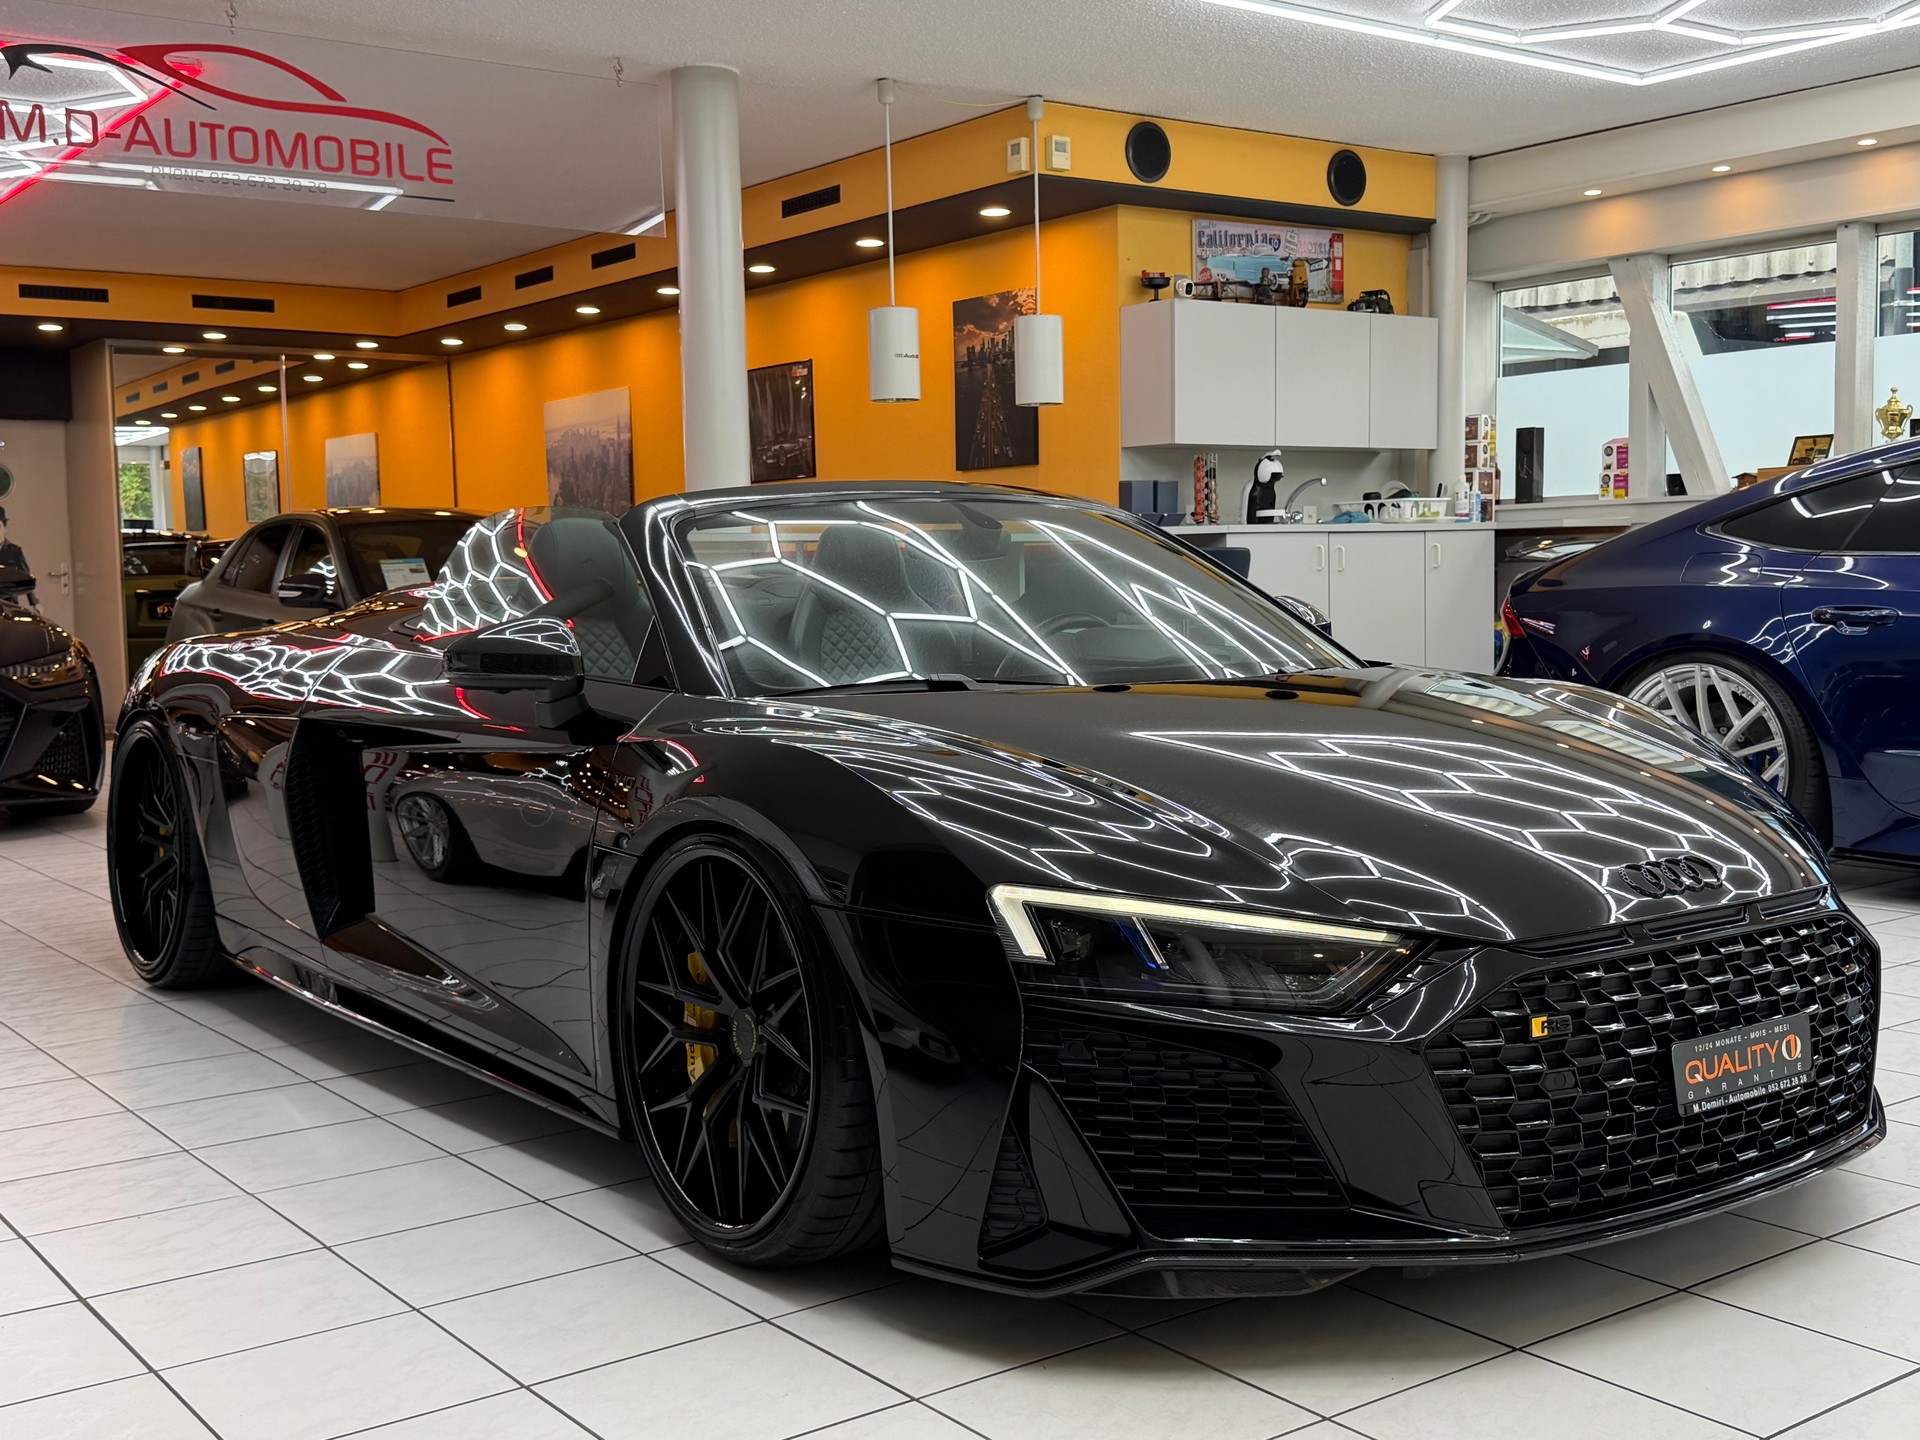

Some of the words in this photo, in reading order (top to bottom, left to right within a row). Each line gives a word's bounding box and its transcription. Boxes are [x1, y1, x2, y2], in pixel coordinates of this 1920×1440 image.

[0, 102, 454, 184] M.D-AUTOMOBILE
[151, 166, 205, 183] PHONE
[247, 175, 277, 190] 672
[1198, 230, 1267, 248] California
[1694, 1041, 1713, 1052] 12/24
[1715, 1035, 1742, 1048] MONATE
[1750, 1029, 1767, 1039] MOIS
[1774, 1024, 1790, 1033] MESI
[1685, 1040, 1779, 1084] QUALITY
[1687, 1062, 1802, 1100] GARANTIE
[1767, 1082, 1779, 1093] 052
[1779, 1079, 1790, 1090] 672
